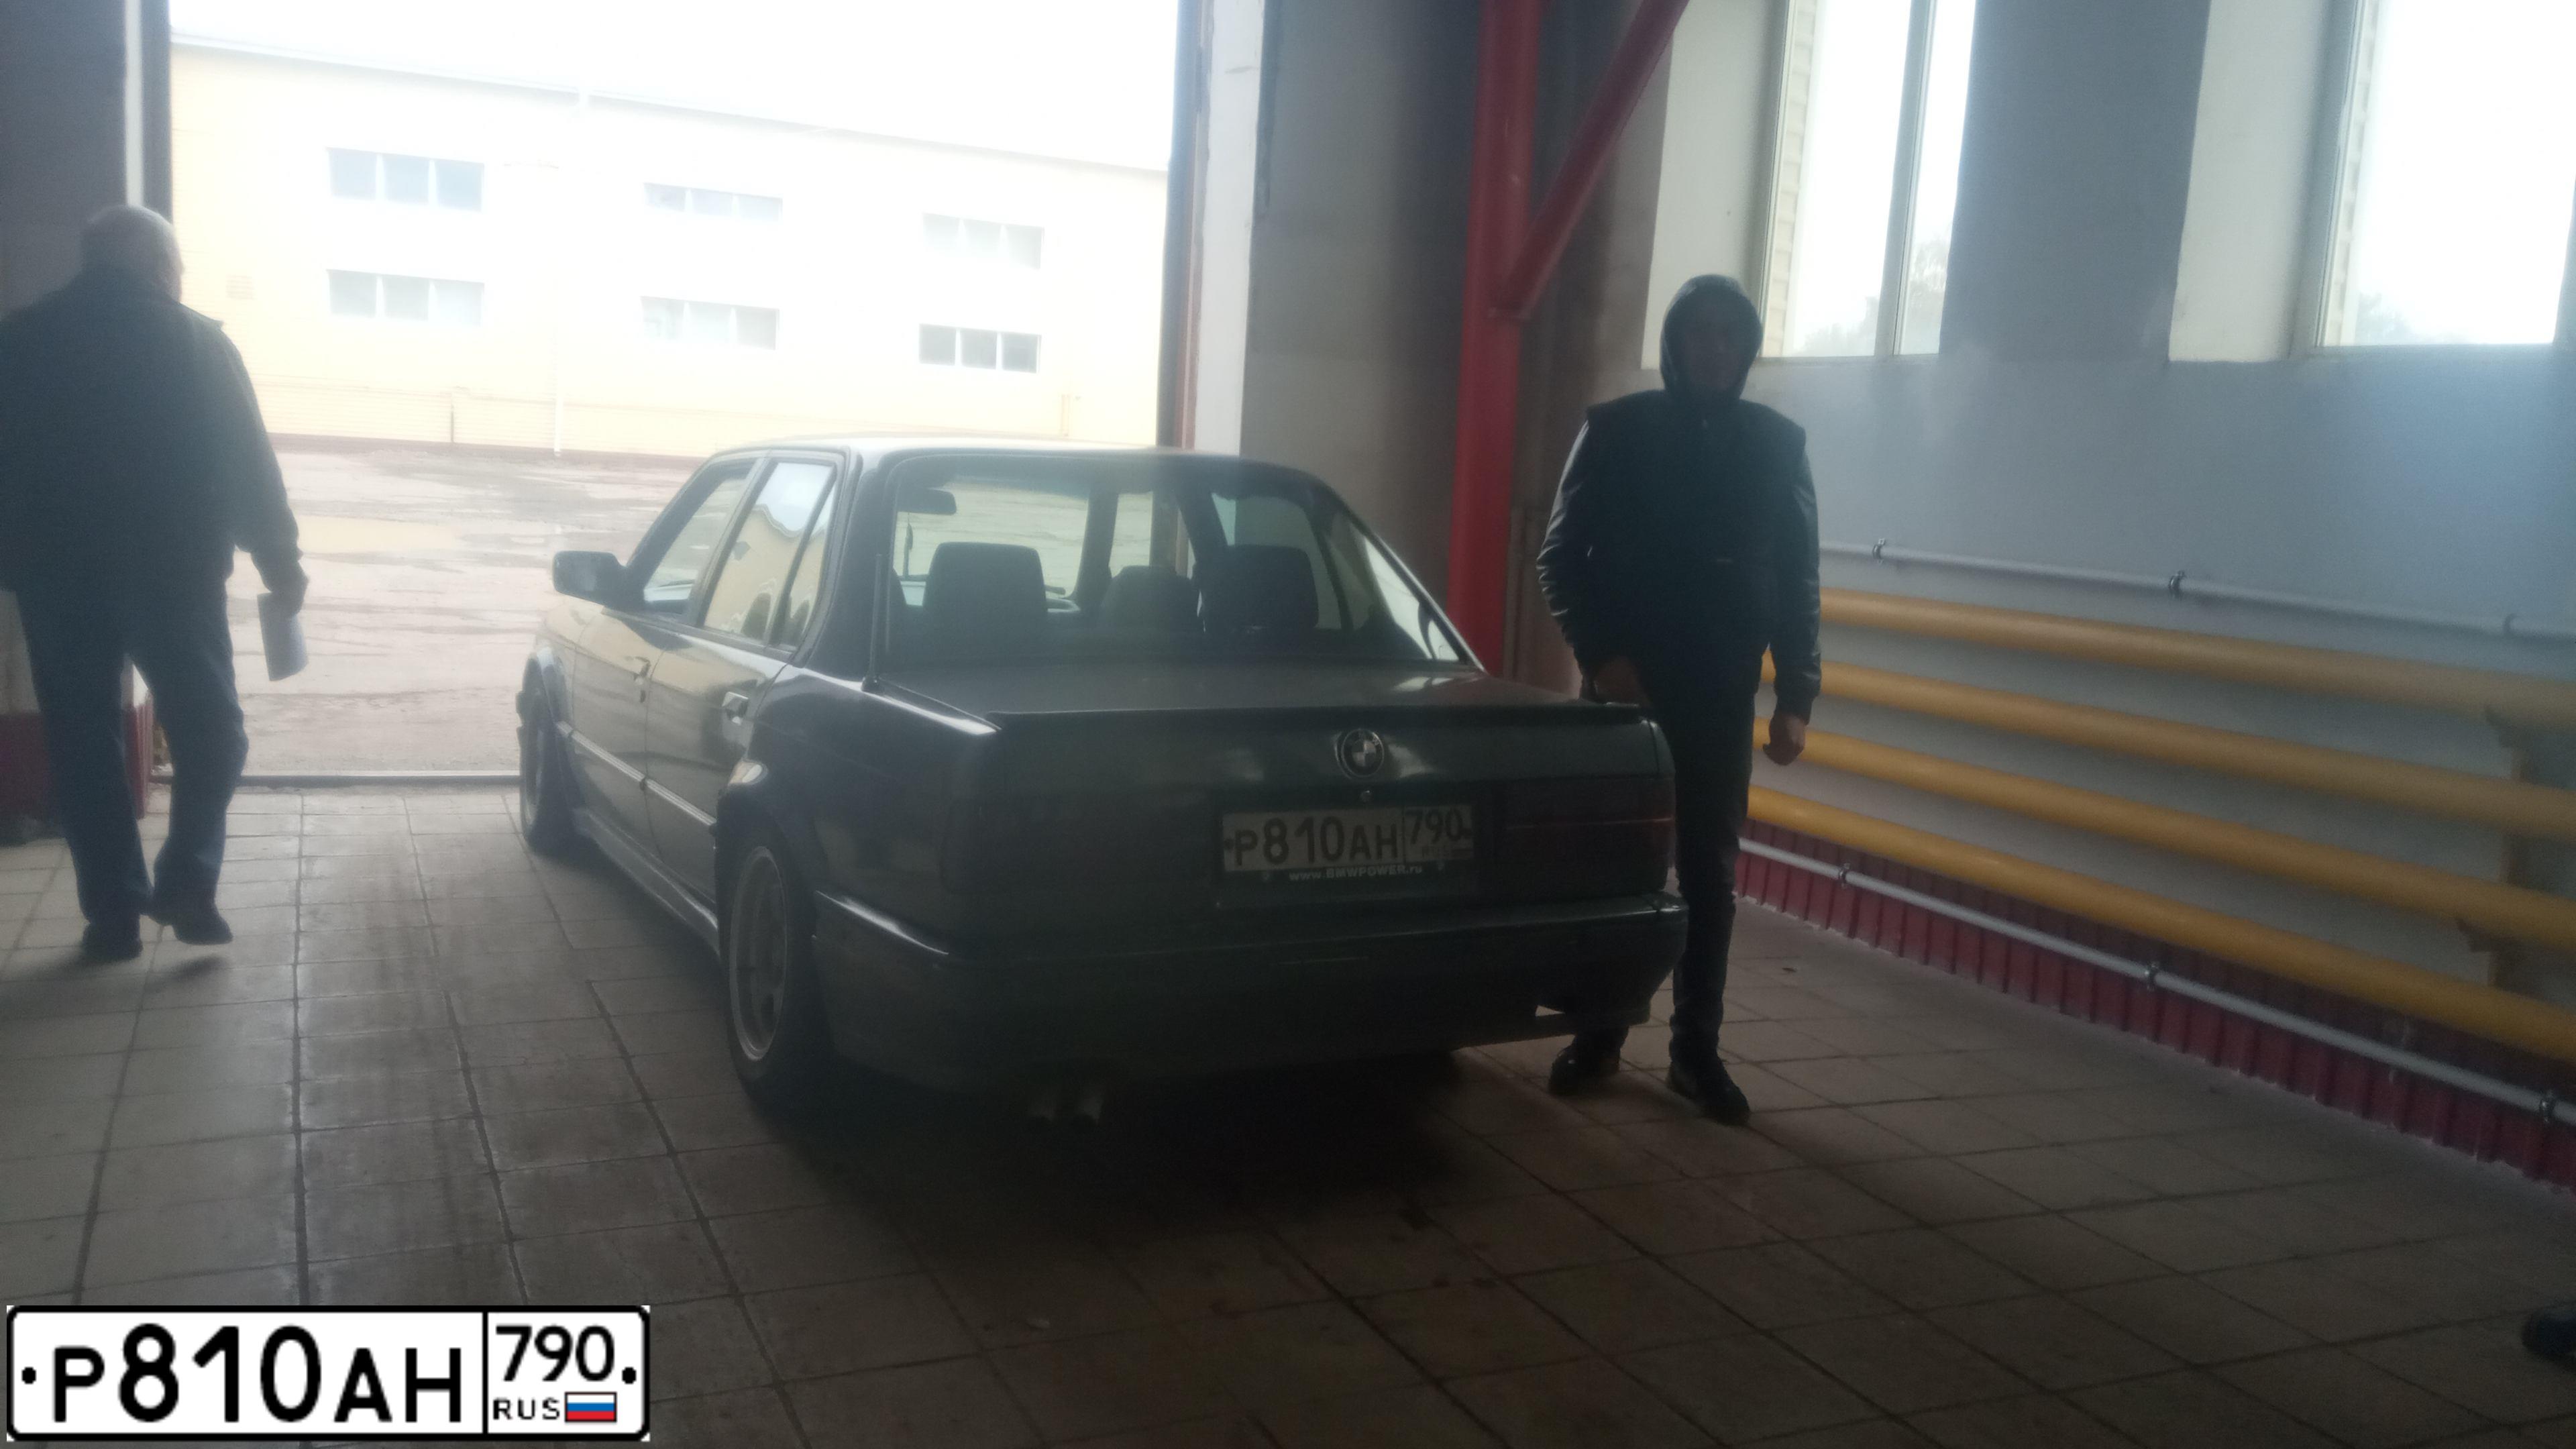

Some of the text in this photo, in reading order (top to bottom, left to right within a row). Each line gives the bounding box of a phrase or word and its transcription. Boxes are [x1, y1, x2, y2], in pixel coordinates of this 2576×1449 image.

[1234, 808, 1464, 866] P810AH 790
[1289, 865, 1423, 881] www.BMWPOWER.ru
